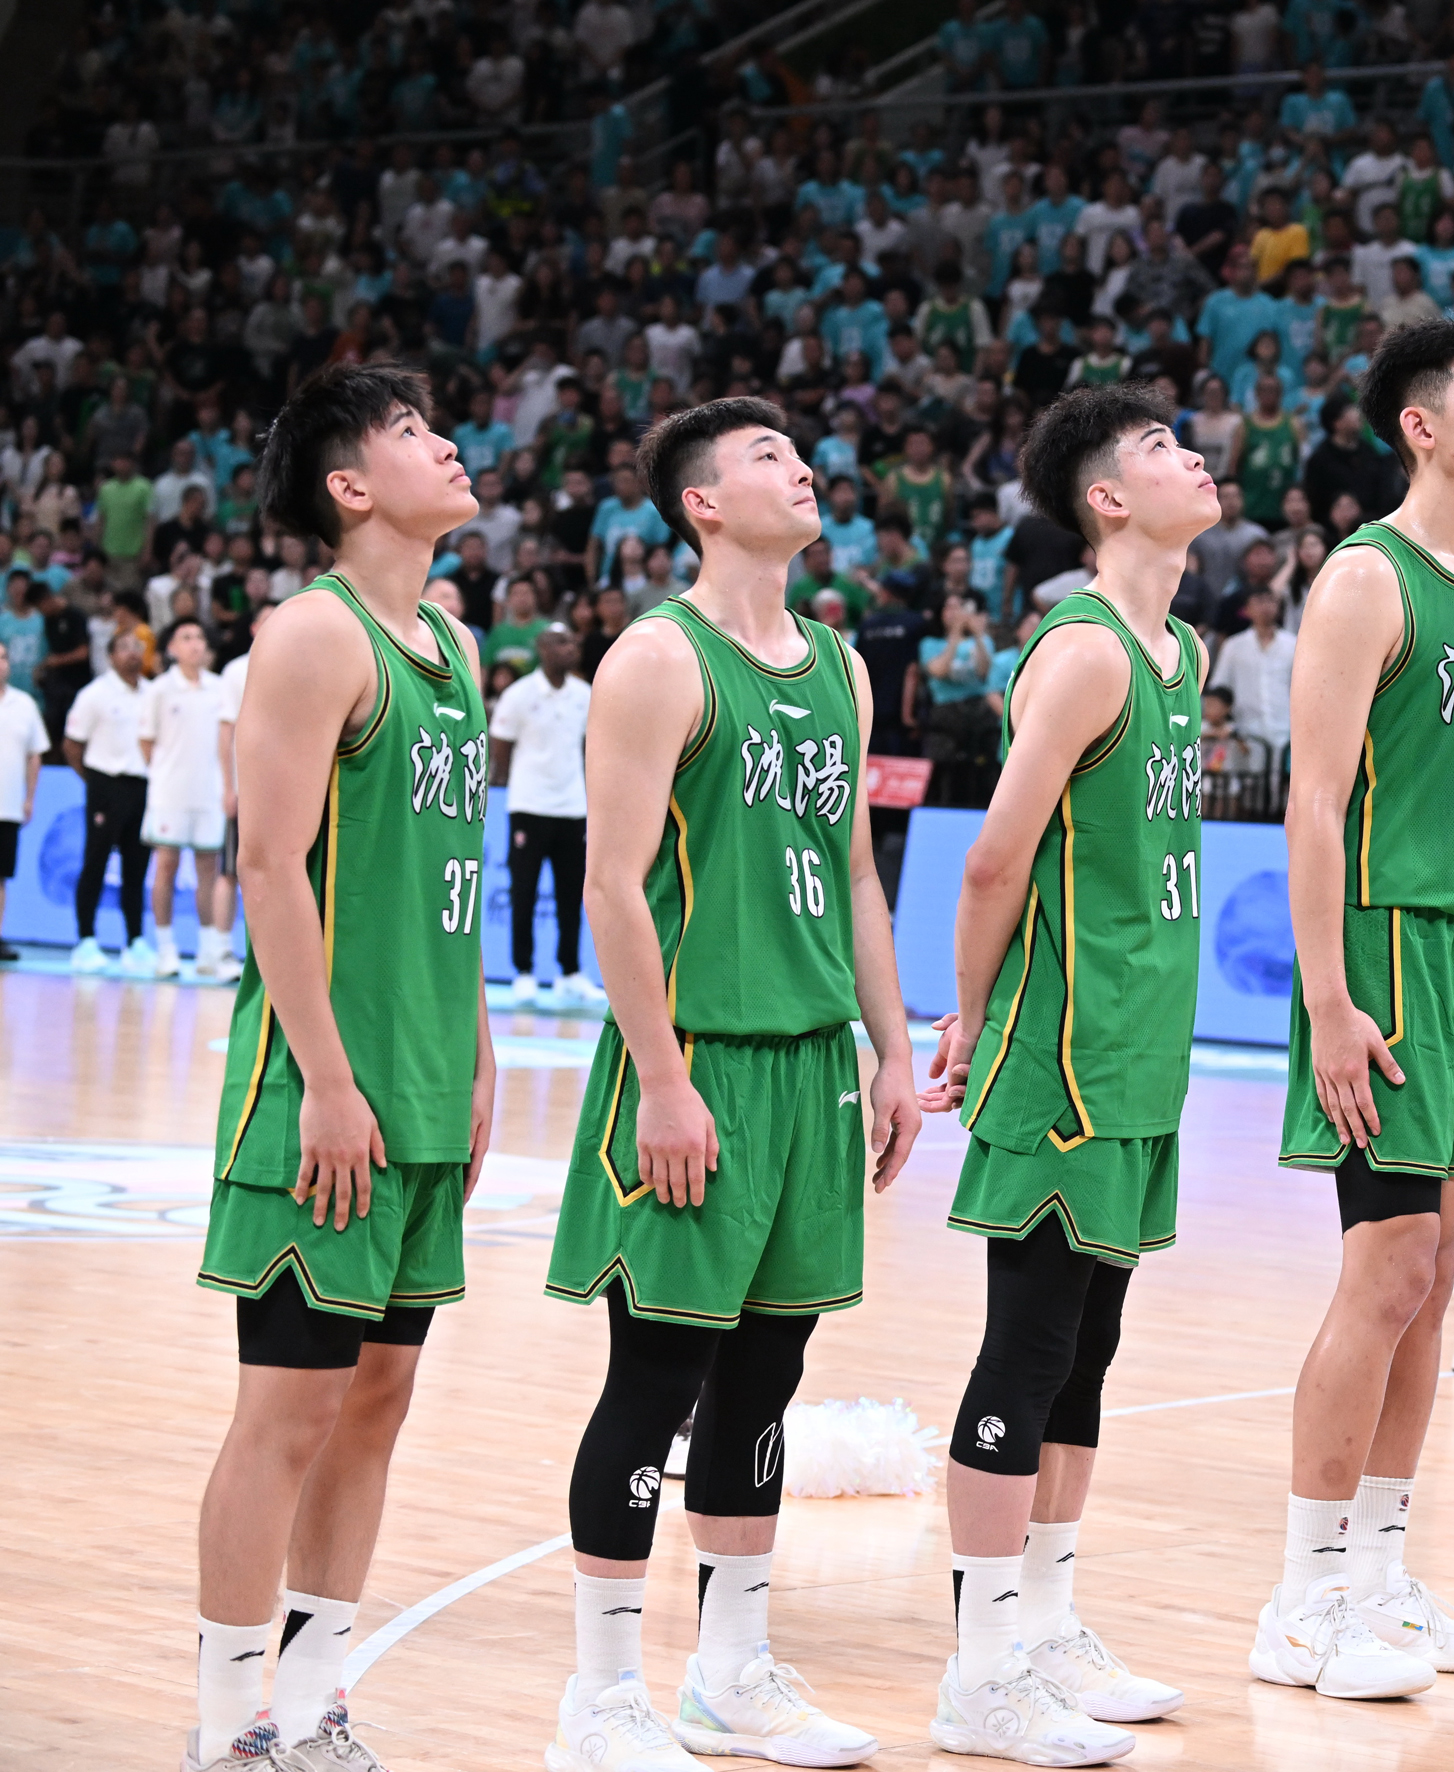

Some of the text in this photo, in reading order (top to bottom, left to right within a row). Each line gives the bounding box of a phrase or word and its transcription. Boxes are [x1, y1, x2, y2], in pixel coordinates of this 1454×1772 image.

[741, 723, 852, 827] 沈陽
[441, 857, 479, 936] 37
[785, 845, 825, 918] 36
[1160, 850, 1199, 921] 31
[976, 1441, 999, 1452] CBA
